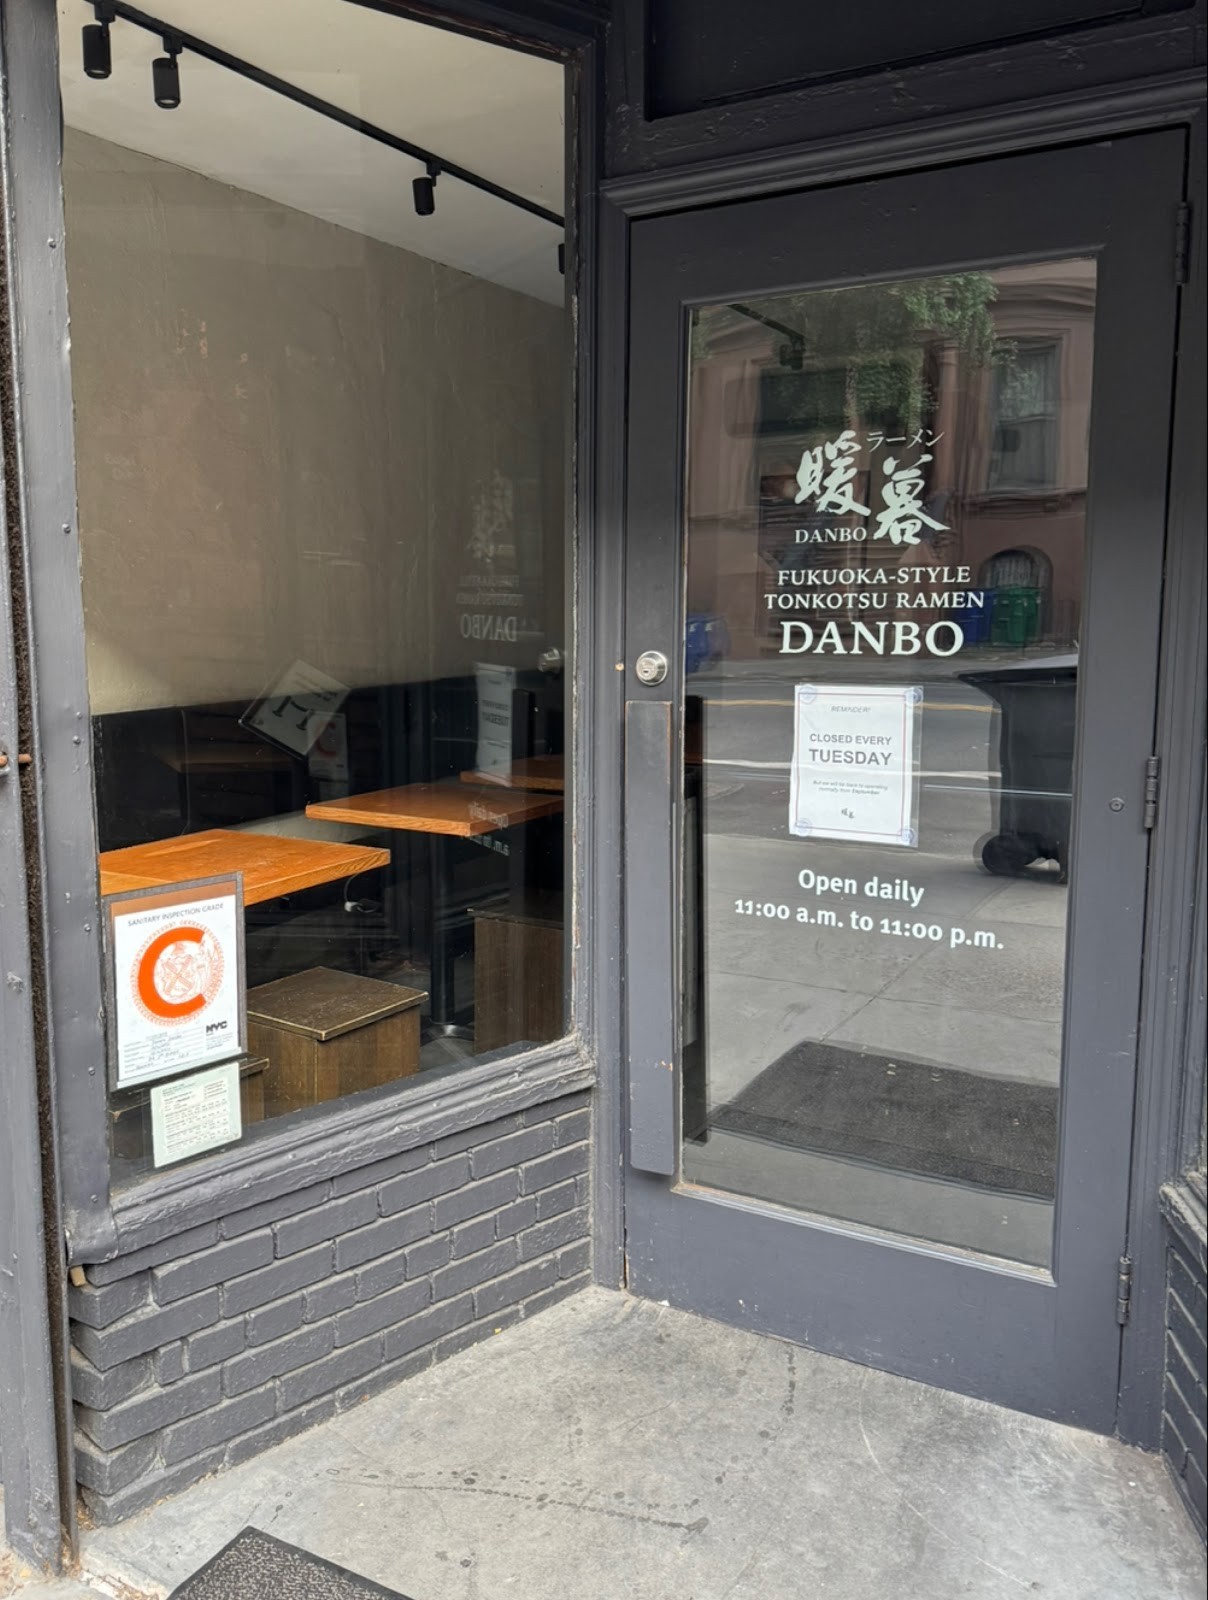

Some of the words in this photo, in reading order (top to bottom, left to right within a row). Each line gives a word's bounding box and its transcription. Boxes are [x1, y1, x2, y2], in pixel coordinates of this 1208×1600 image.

[866, 429, 945, 452] ラーメン
[795, 430, 951, 545] 暖暮
[795, 527, 867, 543] DANBO
[777, 566, 971, 585] FUKUOKA-STYLE
[764, 593, 888, 610] TONKOTSU
[896, 592, 985, 608] RAMEN
[779, 620, 964, 656] DANBO
[809, 733, 853, 743] CLOSED
[855, 735, 892, 745] EVERY
[809, 748, 892, 766] TUESDAY
[798, 869, 857, 895] Open
[864, 876, 925, 908] daily
[128, 914, 161, 927] SANITARY
[161, 906, 201, 920] INSPECTION
[201, 903, 224, 912] GRADE
[734, 899, 790, 920] 11:00
[796, 906, 844, 928] a.m.
[850, 911, 873, 931] to
[880, 917, 943, 941] 11:00
[949, 925, 1004, 949] p.m.
[138, 926, 206, 1018] C
[206, 1020, 228, 1033] NYC
